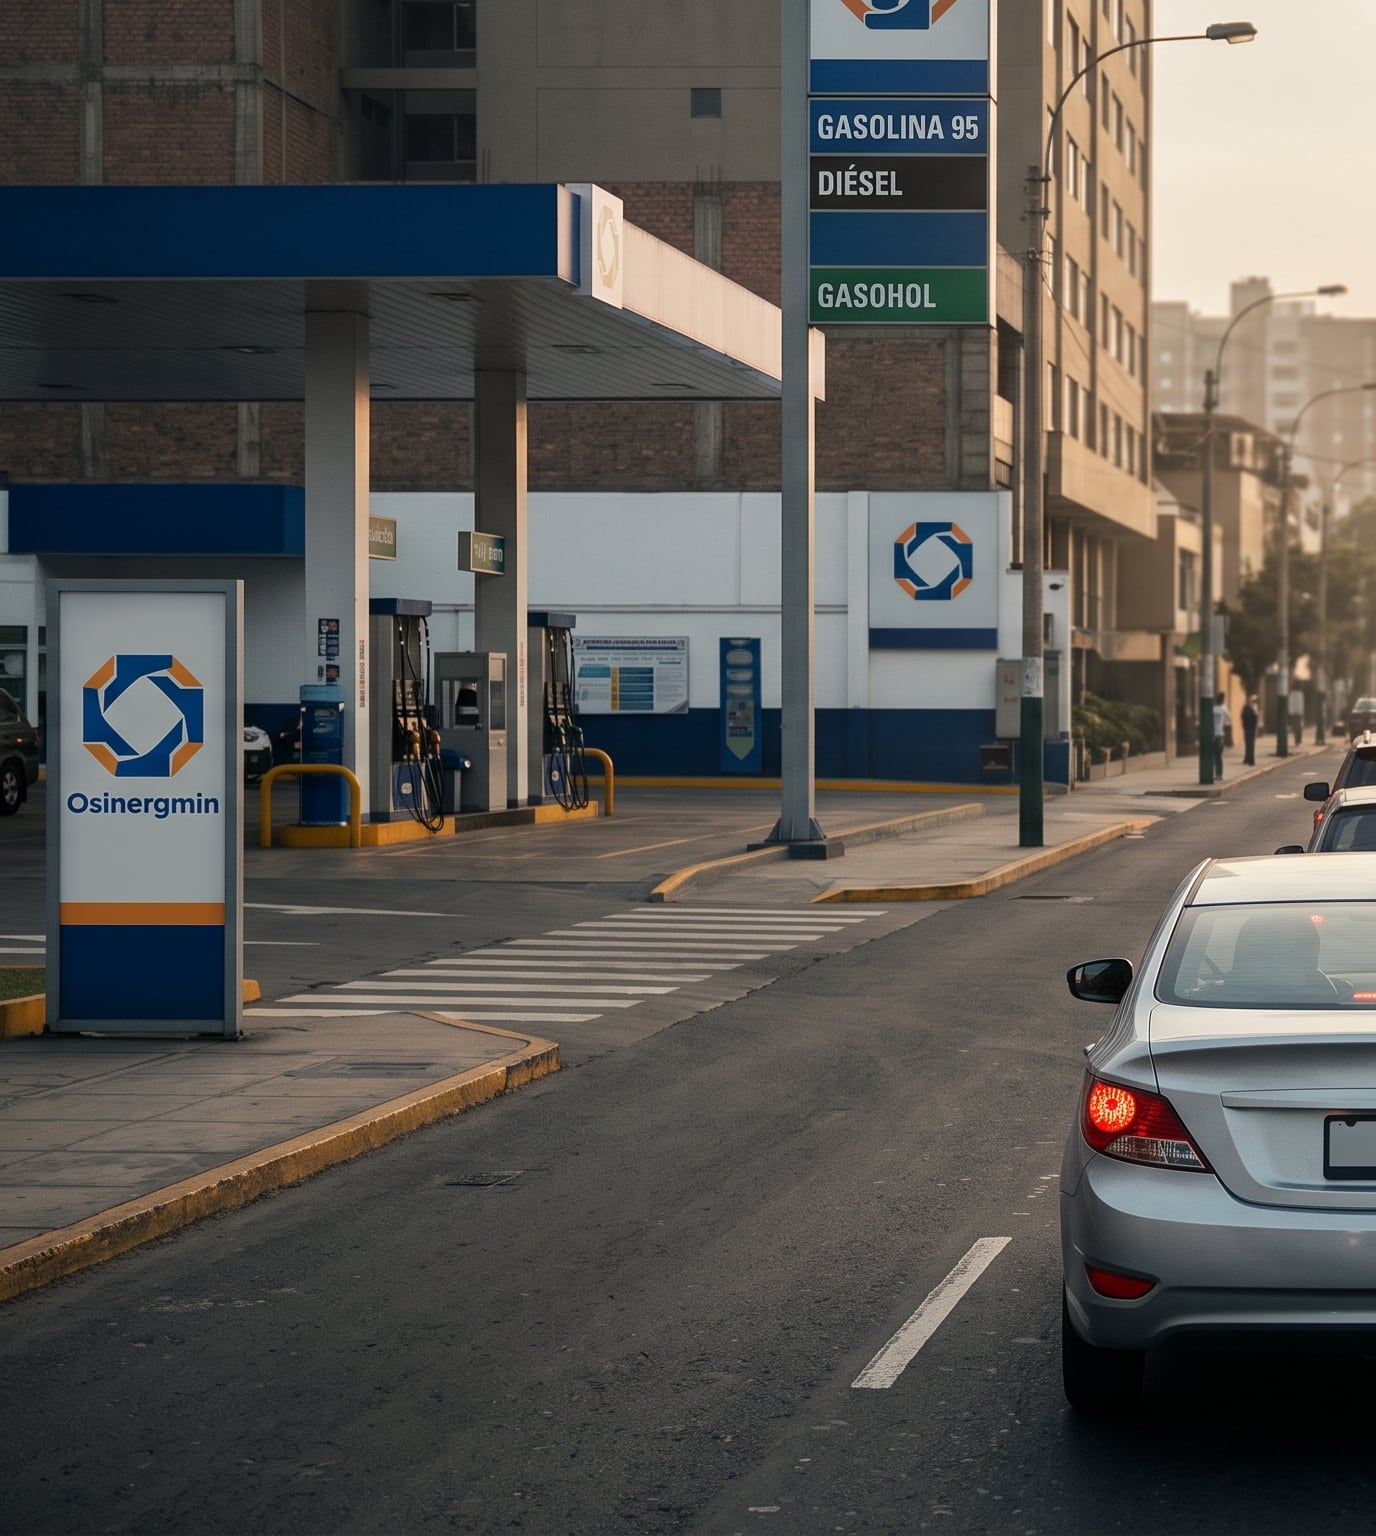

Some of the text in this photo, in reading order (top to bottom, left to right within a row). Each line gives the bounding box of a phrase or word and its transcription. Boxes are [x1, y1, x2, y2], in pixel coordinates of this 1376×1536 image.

[817, 114, 979, 140] GASOLINA 95
[817, 164, 903, 196] DIÉSEL
[817, 282, 937, 308] GASOHOL
[66, 791, 219, 819] Osinergmin
